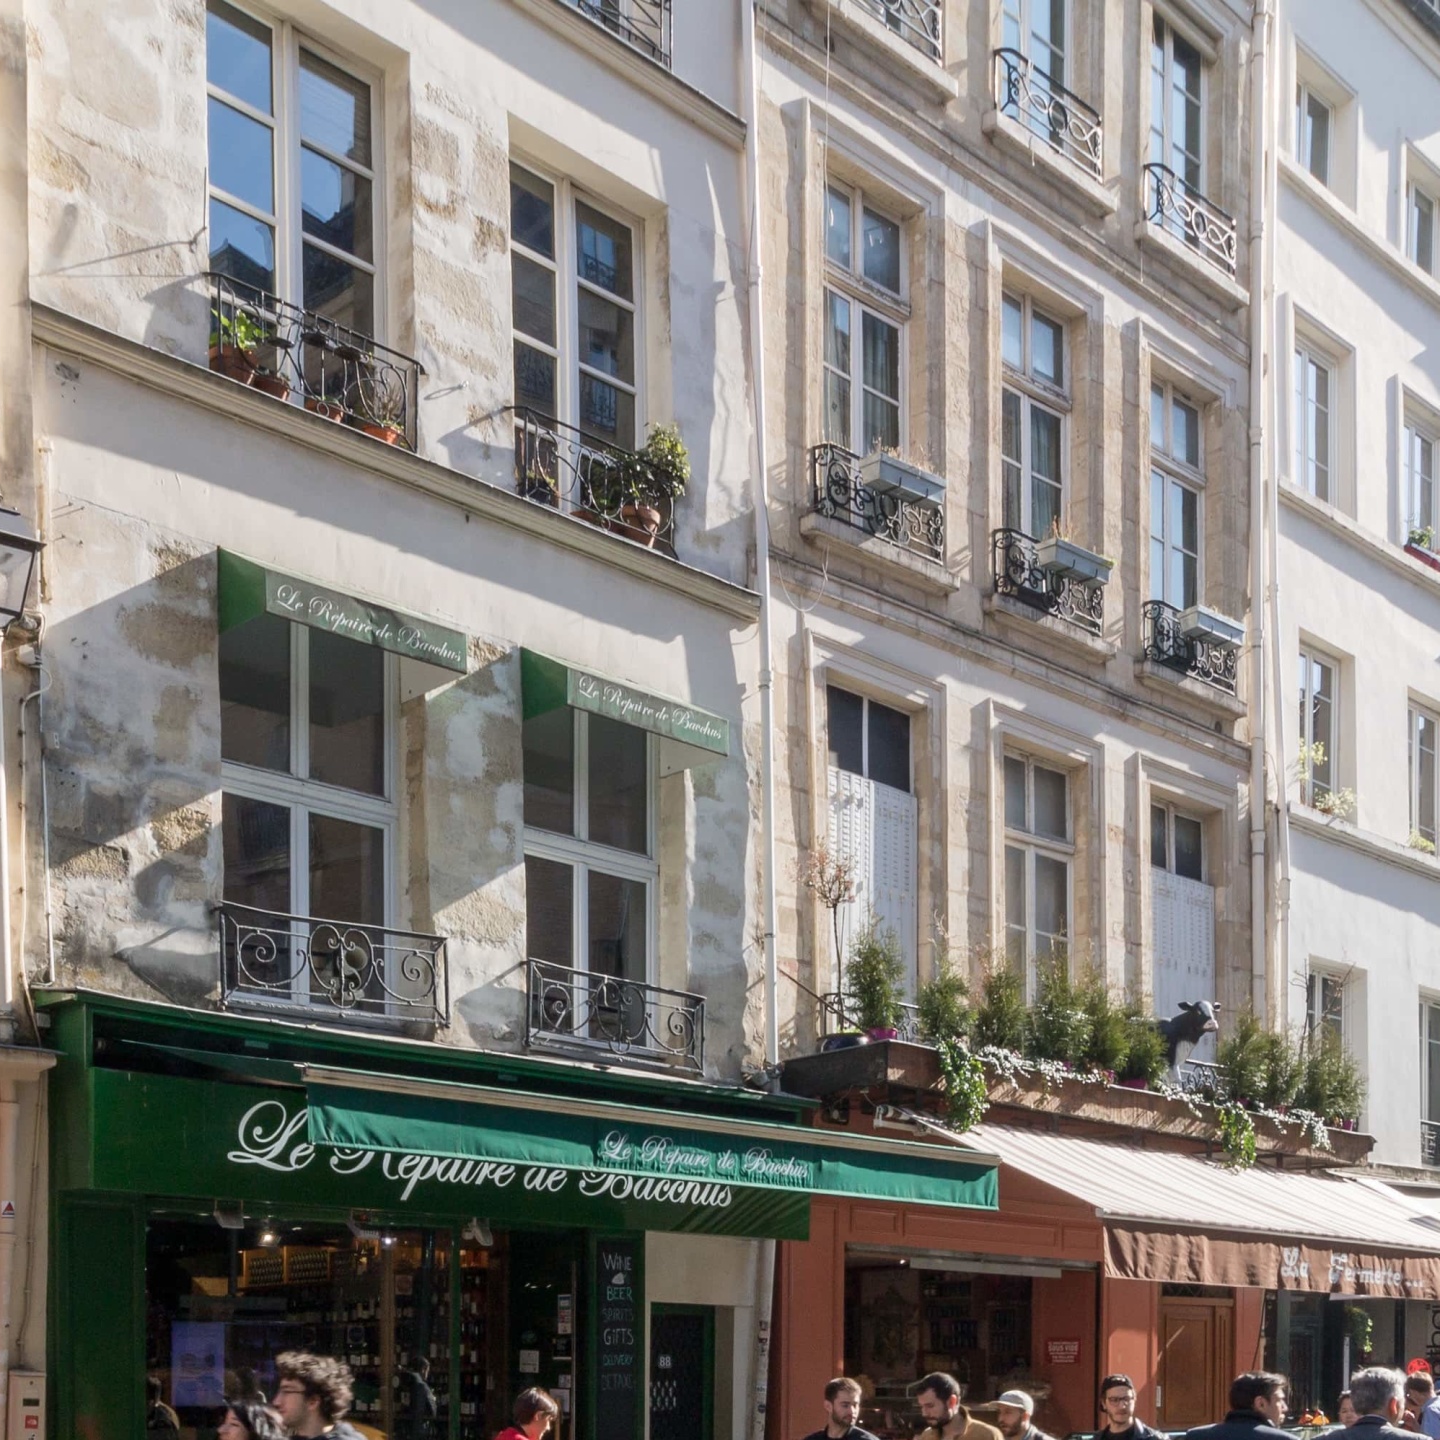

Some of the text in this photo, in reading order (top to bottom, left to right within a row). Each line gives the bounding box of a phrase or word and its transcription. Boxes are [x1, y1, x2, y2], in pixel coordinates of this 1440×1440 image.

[275, 584, 462, 662] Le Repaire de Bacchus
[578, 674, 722, 740] Le Repaire de Bacchus
[227, 1100, 314, 1172] Le
[601, 1130, 810, 1179] Le Repaire de Bacchus
[606, 1286, 633, 1302] BEER
[659, 1355, 672, 1368] 88
